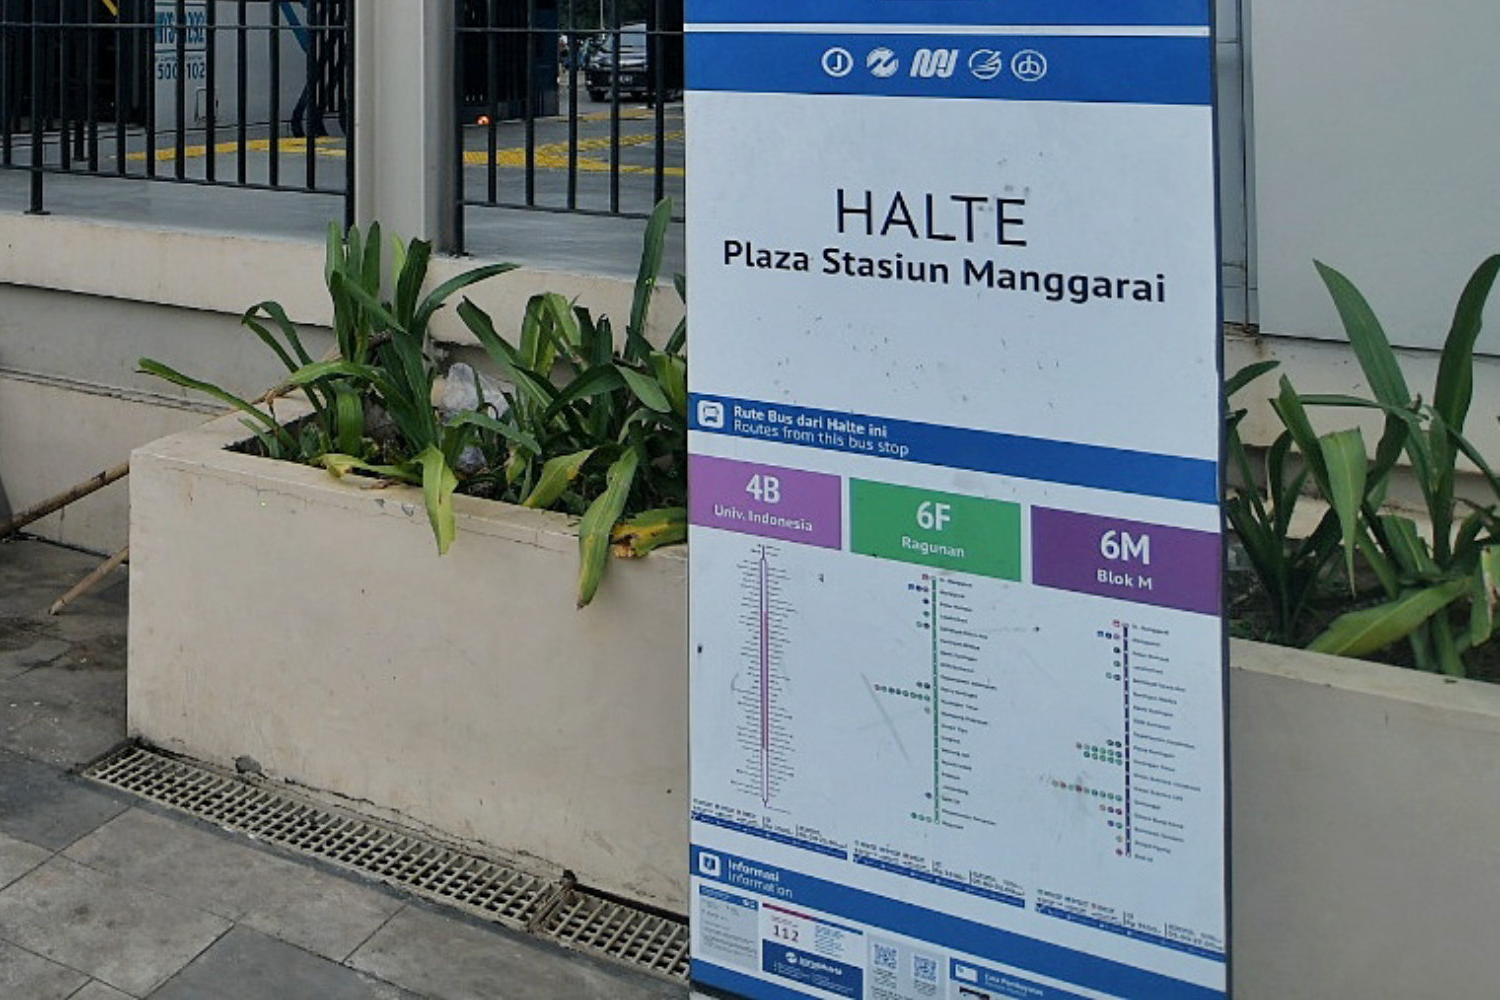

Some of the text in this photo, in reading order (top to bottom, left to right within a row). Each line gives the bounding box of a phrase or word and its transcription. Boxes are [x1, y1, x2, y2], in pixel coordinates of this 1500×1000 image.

[836, 188, 1028, 247] HALTE
[723, 239, 1166, 304] Plaza Stasiun Manggarai
[733, 405, 888, 438] Rute Bus dari Halte ini
[733, 419, 909, 458] Routes from this bus stop
[745, 473, 781, 504] 4B
[713, 503, 813, 532] Univ. Indonesia
[916, 500, 951, 531] 6F
[901, 535, 965, 558] Ragunan
[1100, 530, 1150, 565] 6M
[1096, 568, 1152, 591] Blok M
[727, 858, 780, 882] Informasi
[727, 872, 794, 899] Information
[773, 924, 800, 943] 112
